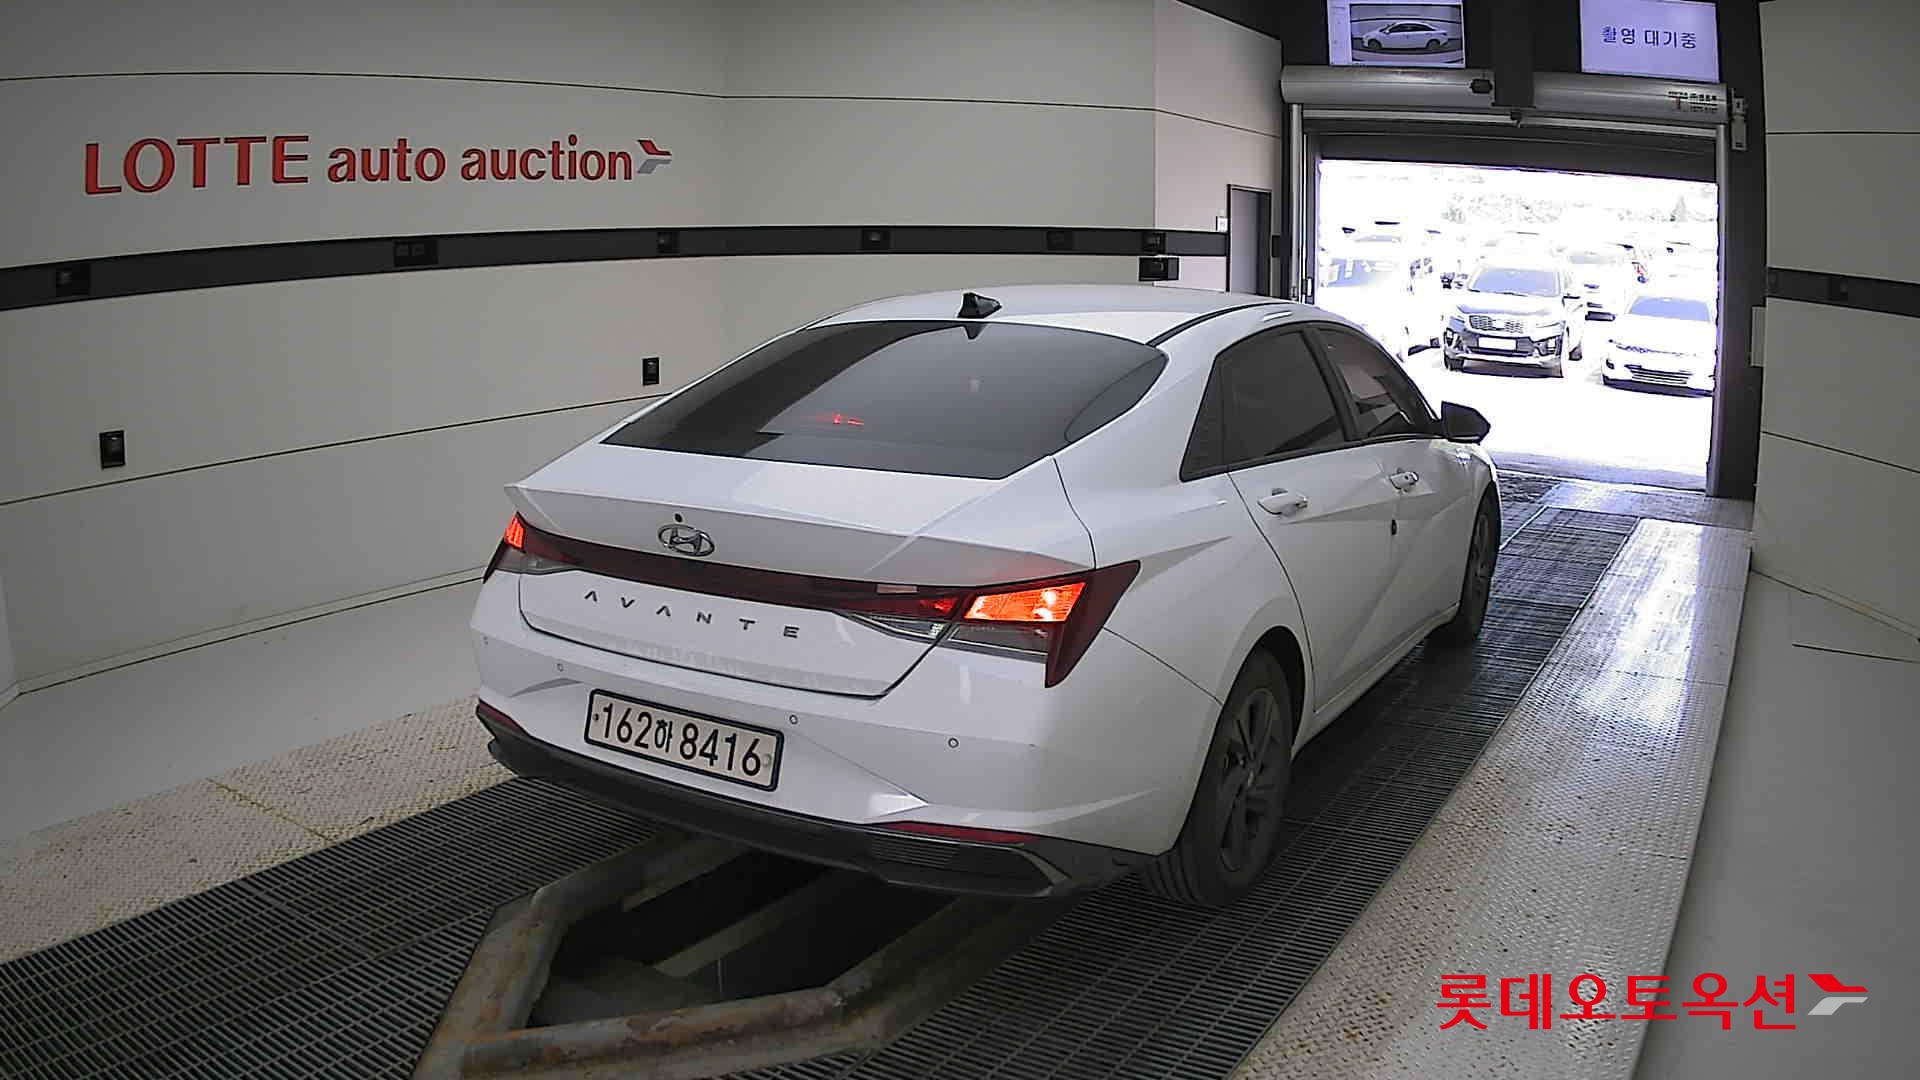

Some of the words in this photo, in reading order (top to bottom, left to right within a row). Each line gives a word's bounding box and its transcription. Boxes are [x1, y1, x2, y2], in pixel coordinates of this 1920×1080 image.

[1643, 29, 1697, 49] 대기중
[84, 135, 309, 195] LOTTE
[327, 138, 446, 183] auto
[459, 134, 633, 181] auction
[584, 590, 800, 638] AVANTE
